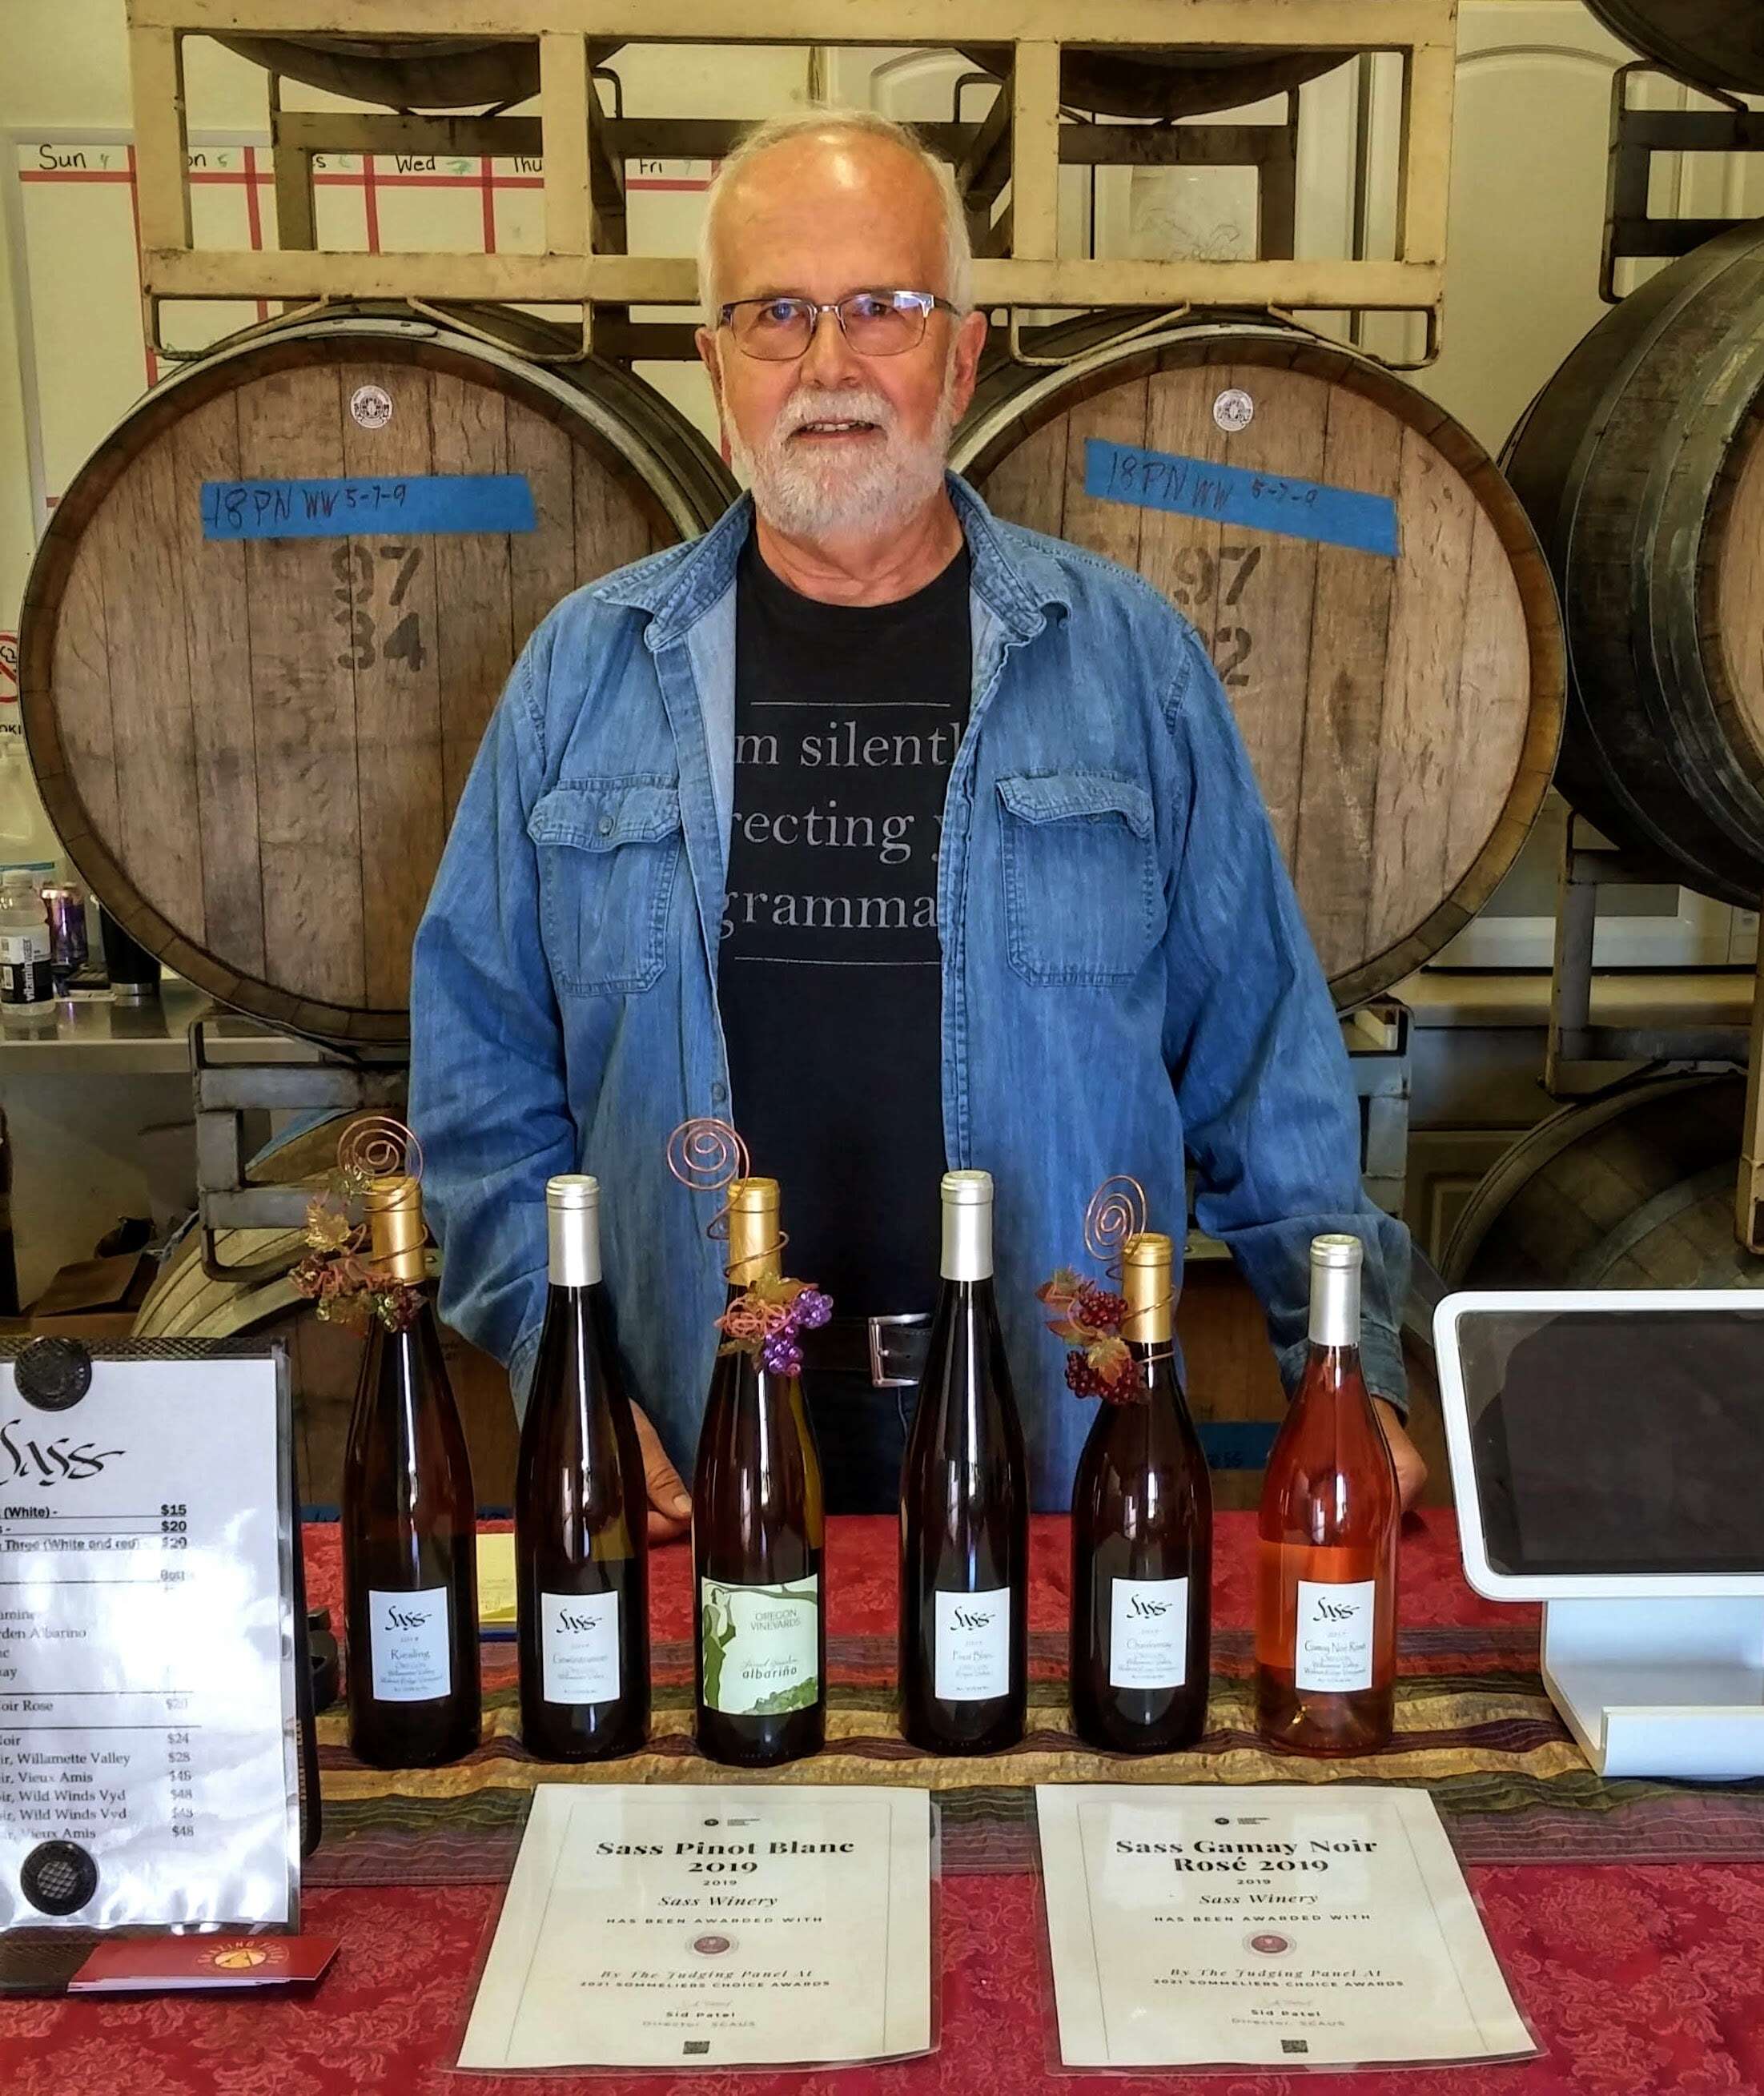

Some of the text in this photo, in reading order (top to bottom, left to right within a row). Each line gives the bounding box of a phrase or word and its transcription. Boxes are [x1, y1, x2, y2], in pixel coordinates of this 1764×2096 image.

[39, 144, 86, 170] Sun
[395, 155, 436, 173] Wed
[332, 544, 423, 606] 97
[1172, 546, 1261, 605] 97
[334, 609, 427, 673] 34
[735, 721, 961, 767] m silentl
[721, 890, 938, 940] gramma
[4, 1504, 187, 1520] (White) $15
[162, 1520, 187, 1532] $20
[755, 1609, 798, 1621] OREGON
[749, 1619, 802, 1632] VINEYARDS
[742, 1665, 798, 1680] albariño
[0, 1700, 19, 1712] oir
[0, 1733, 189, 1746] oir $24
[17, 1753, 86, 1765] Willamette
[90, 1752, 131, 1767] Valley
[59, 1772, 94, 1783] Amis
[19, 1790, 50, 1802] Wild
[54, 1789, 96, 1801] Winds
[99, 1789, 127, 1804] Vyd
[20, 1809, 50, 1821] Wild
[55, 1808, 97, 1821] Winds
[62, 1827, 96, 1840] Amis
[597, 1840, 854, 1855] Sass Pinot Blanc
[1115, 1839, 1378, 1855] Sass Gamay Noir
[688, 1861, 757, 1873] 2019
[1174, 1856, 1329, 1873] Rosé 2019
[657, 1895, 778, 1908] Sass Winery
[1199, 1893, 1319, 1905] Sass Winery
[1251, 2009, 1321, 2018] Sid Patel
